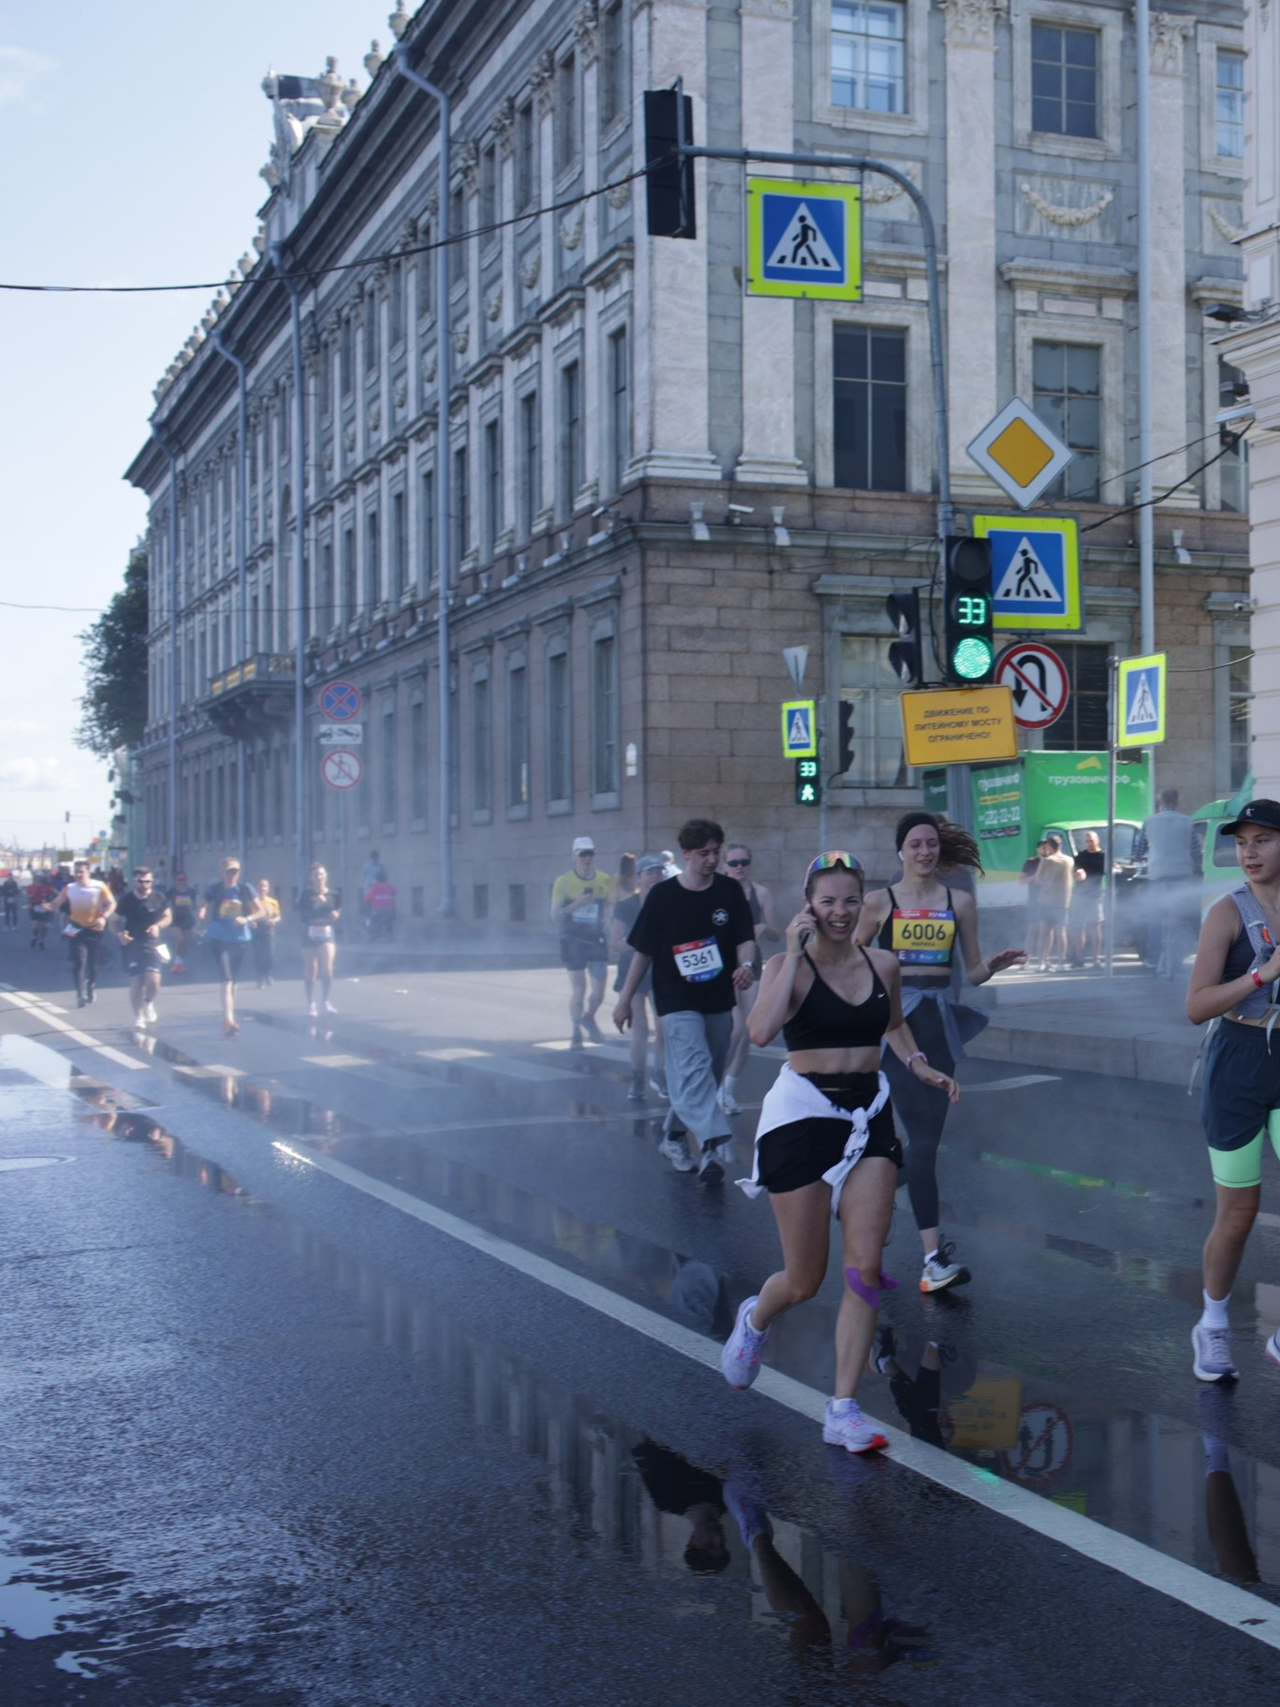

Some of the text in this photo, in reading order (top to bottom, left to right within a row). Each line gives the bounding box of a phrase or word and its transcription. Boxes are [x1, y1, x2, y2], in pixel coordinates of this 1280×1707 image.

[958, 596, 986, 625] 33
[924, 706, 990, 718] ДВИЖЕНИЕ ПО
[971, 717, 1002, 727] МОСТУ
[800, 761, 817, 777] 33
[901, 923, 947, 940] 6006
[682, 949, 715, 968] 5361
